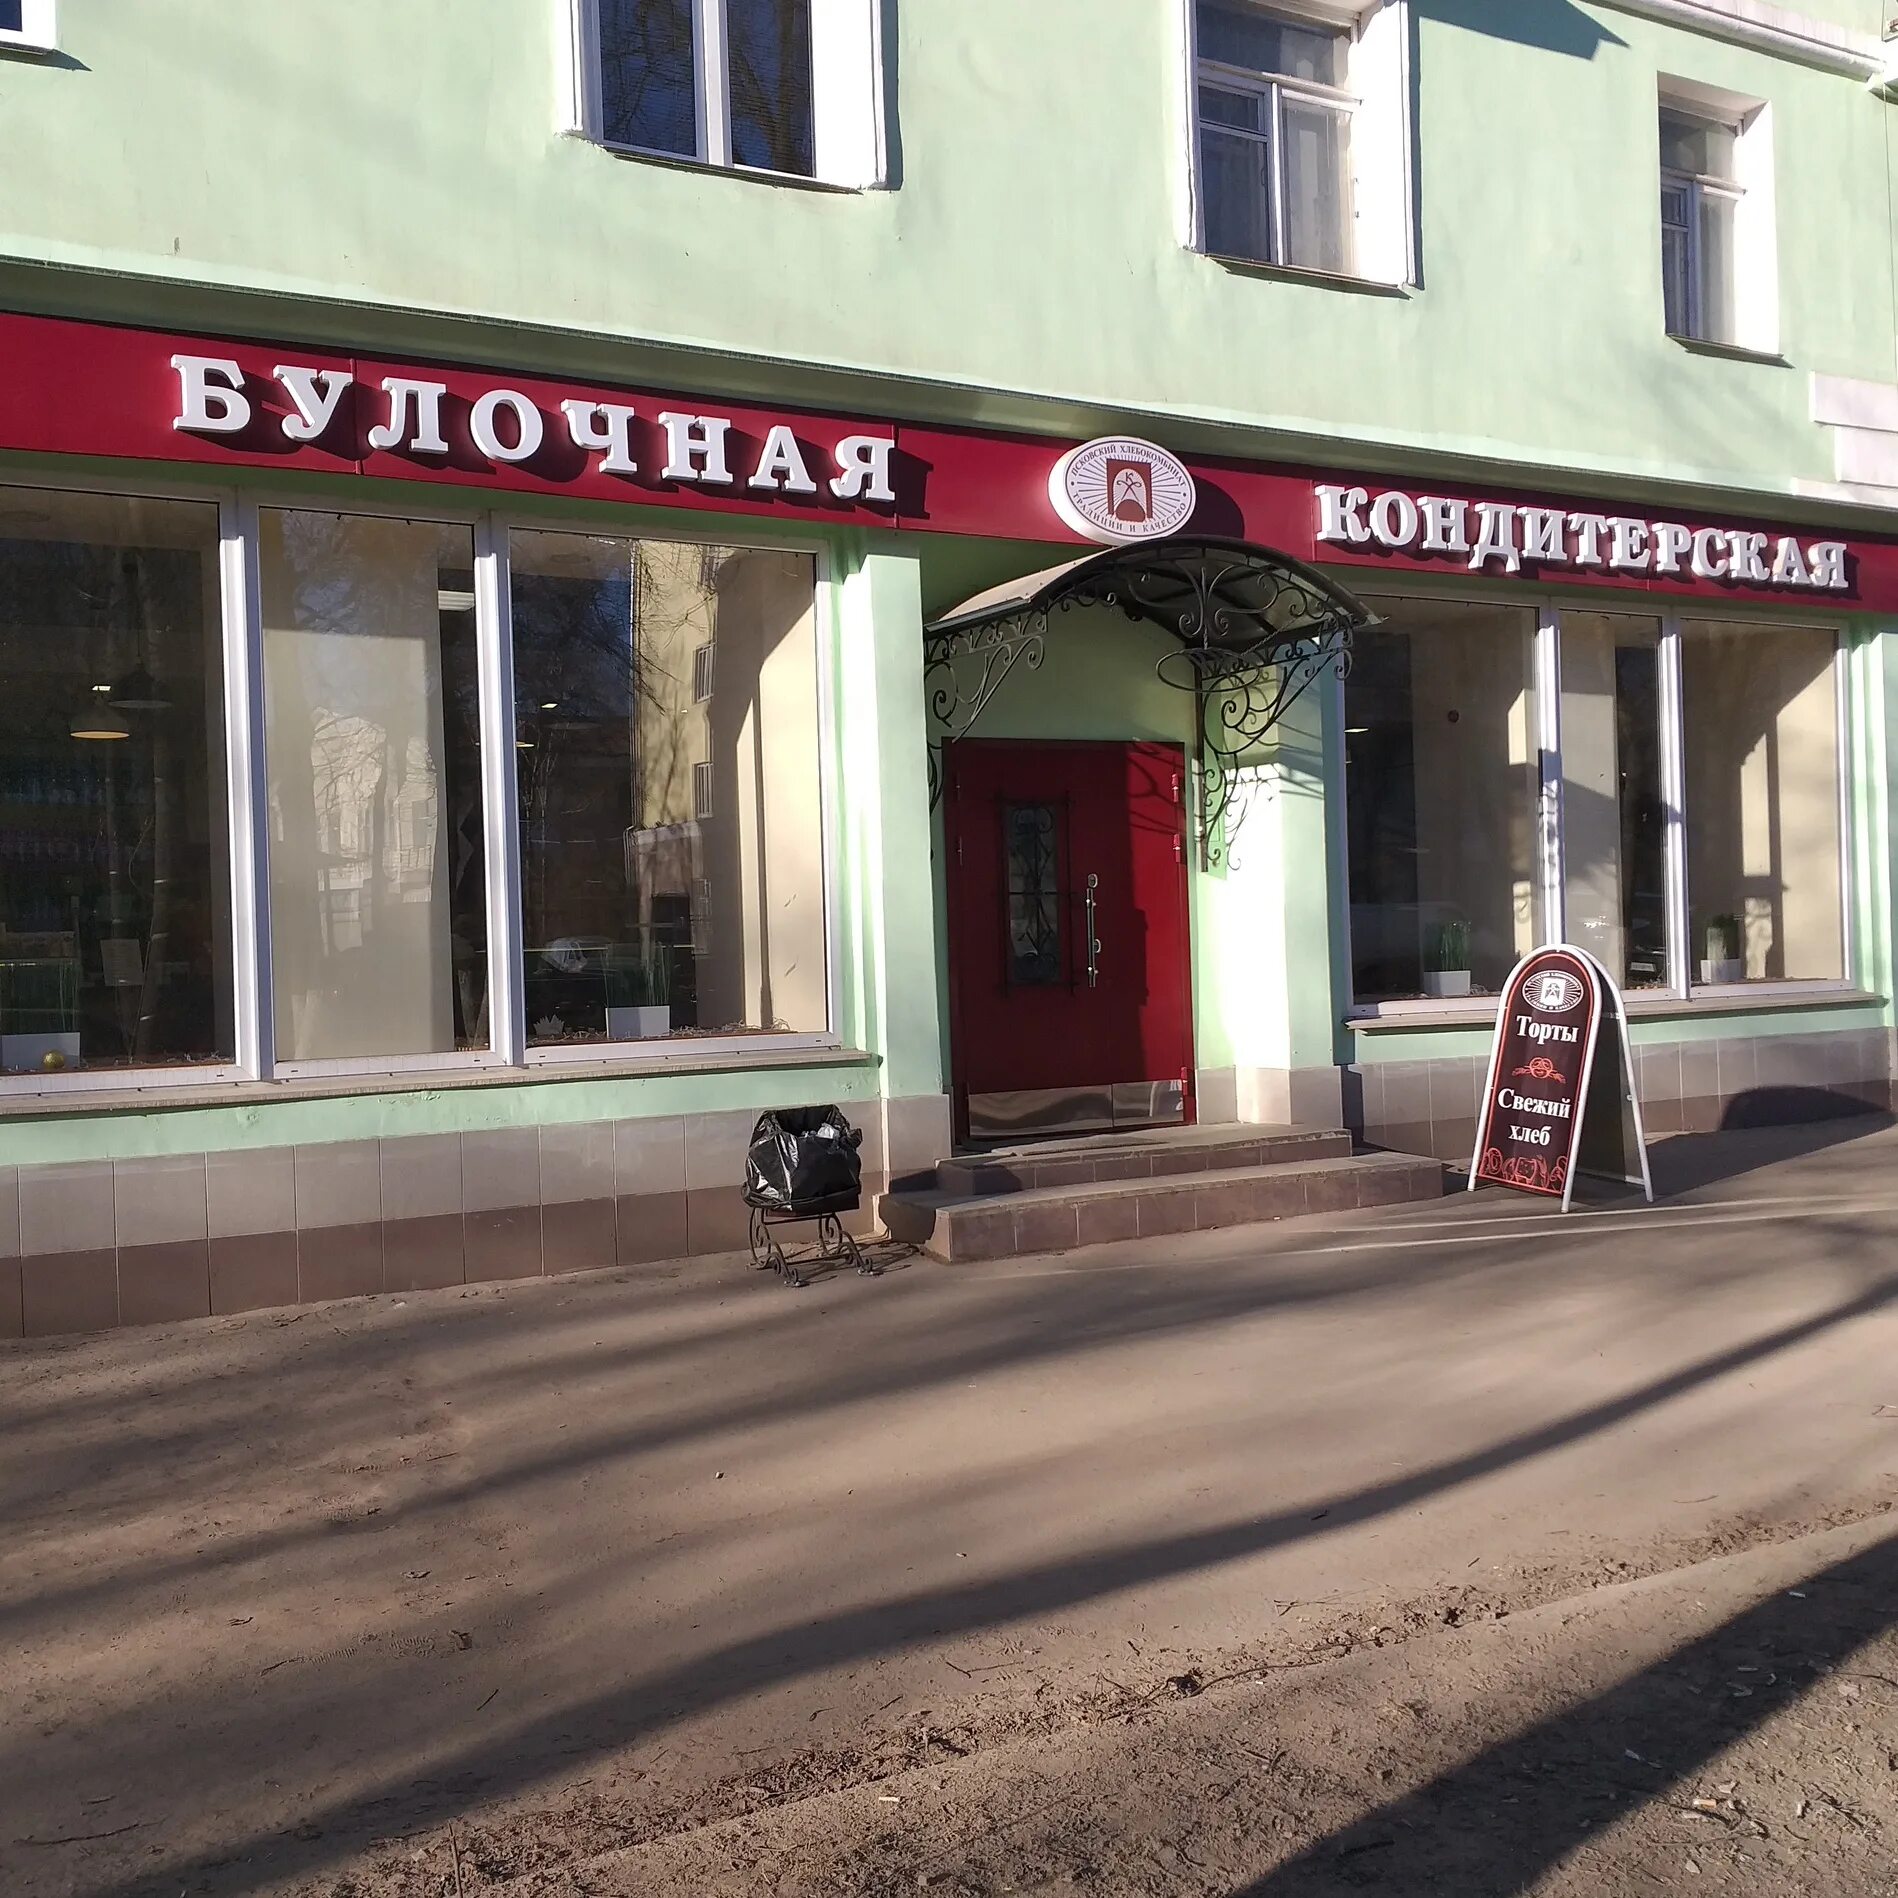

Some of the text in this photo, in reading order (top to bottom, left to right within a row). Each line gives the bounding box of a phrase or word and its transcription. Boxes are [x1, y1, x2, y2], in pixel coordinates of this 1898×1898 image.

[170, 353, 897, 502] БУЛОЧНАЯ
[1071, 444, 1187, 487] ПСКОВСКИЙ ХЛЕБОКОМБИНАТ
[1072, 492, 1187, 533] ТРАДИЦИИ И КАЧЕСТВО
[1314, 484, 1850, 589] КОНДИТЕРСКАЯ
[1516, 1015, 1579, 1044] Торты
[1497, 1088, 1571, 1118] Свежий
[1508, 1124, 1552, 1146] хлеб
